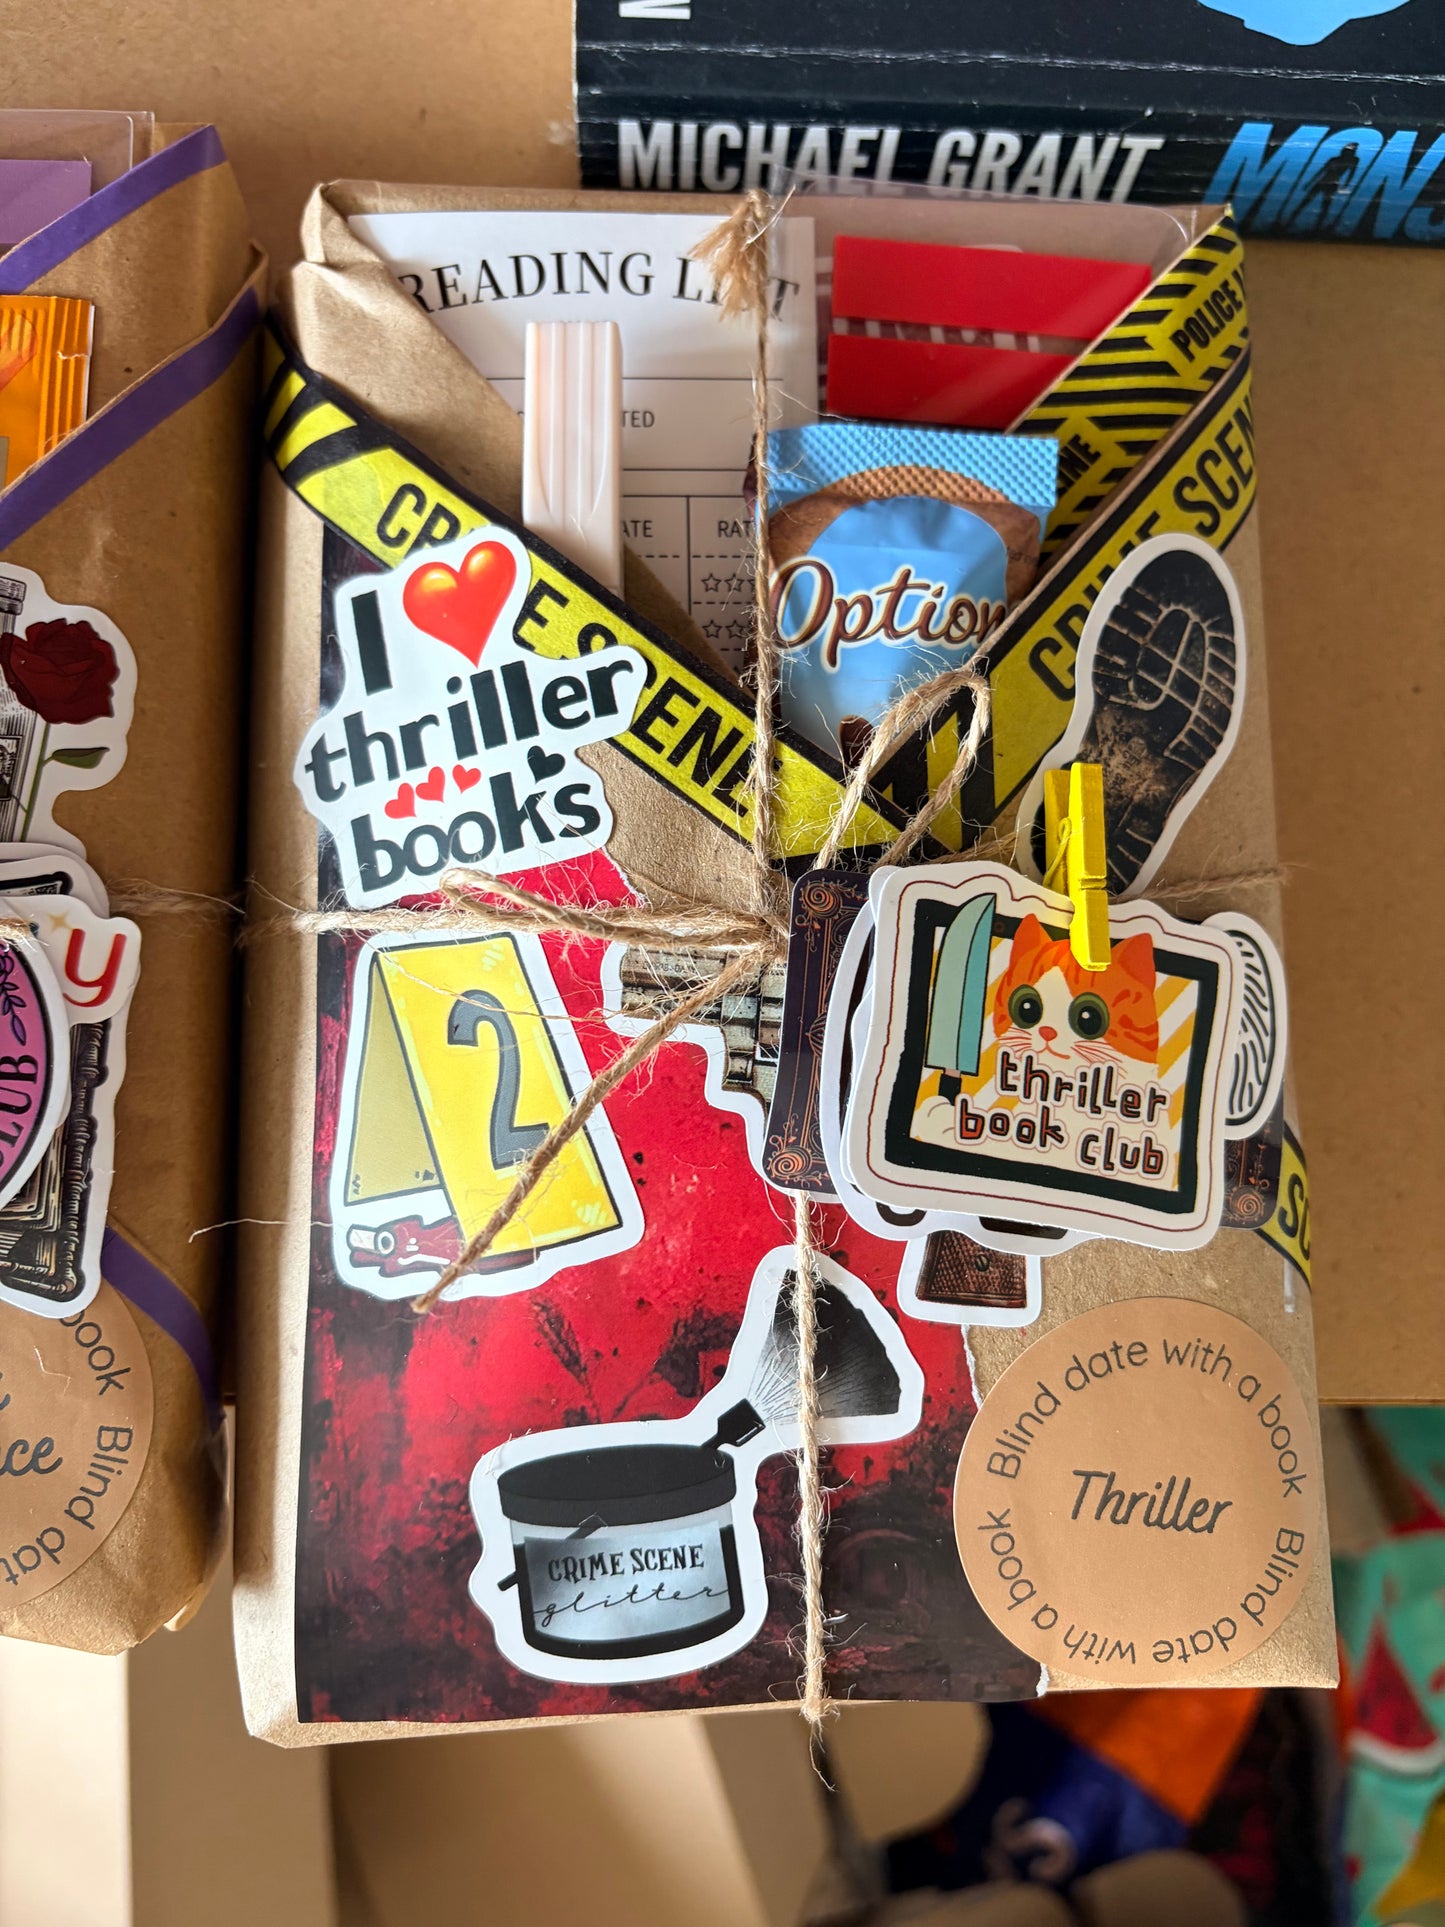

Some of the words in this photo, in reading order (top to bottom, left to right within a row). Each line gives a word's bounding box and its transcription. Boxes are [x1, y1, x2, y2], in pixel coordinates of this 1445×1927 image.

[617, 119, 902, 196] MICHAEL
[927, 128, 1165, 204] GRANT
[399, 250, 656, 313] READING
[1169, 279, 1243, 363] POLICE
[376, 483, 570, 653] CRE
[350, 590, 393, 697] I
[304, 660, 634, 803] thriller
[350, 771, 602, 893] books
[447, 989, 550, 1170] 2
[1000, 1051, 1167, 1122] thriller
[959, 1098, 1065, 1148] book
[1080, 1126, 1164, 1175] club
[1064, 1340, 1149, 1392] date
[1162, 1338, 1233, 1382] with
[1236, 1374, 1263, 1403] a
[986, 1381, 1062, 1480] Blind
[1257, 1393, 1308, 1499] book
[64, 1424, 134, 1530] Blind
[1072, 1468, 1233, 1535] Thriller
[549, 1552, 625, 1583] CRIME
[631, 1544, 705, 1576] SCENE
[977, 1507, 1037, 1611] book
[1240, 1527, 1305, 1627] Blind
[533, 1583, 730, 1628] glitter
[1030, 1603, 1059, 1631] a
[1063, 1624, 1137, 1666] with
[1151, 1616, 1238, 1664] date
